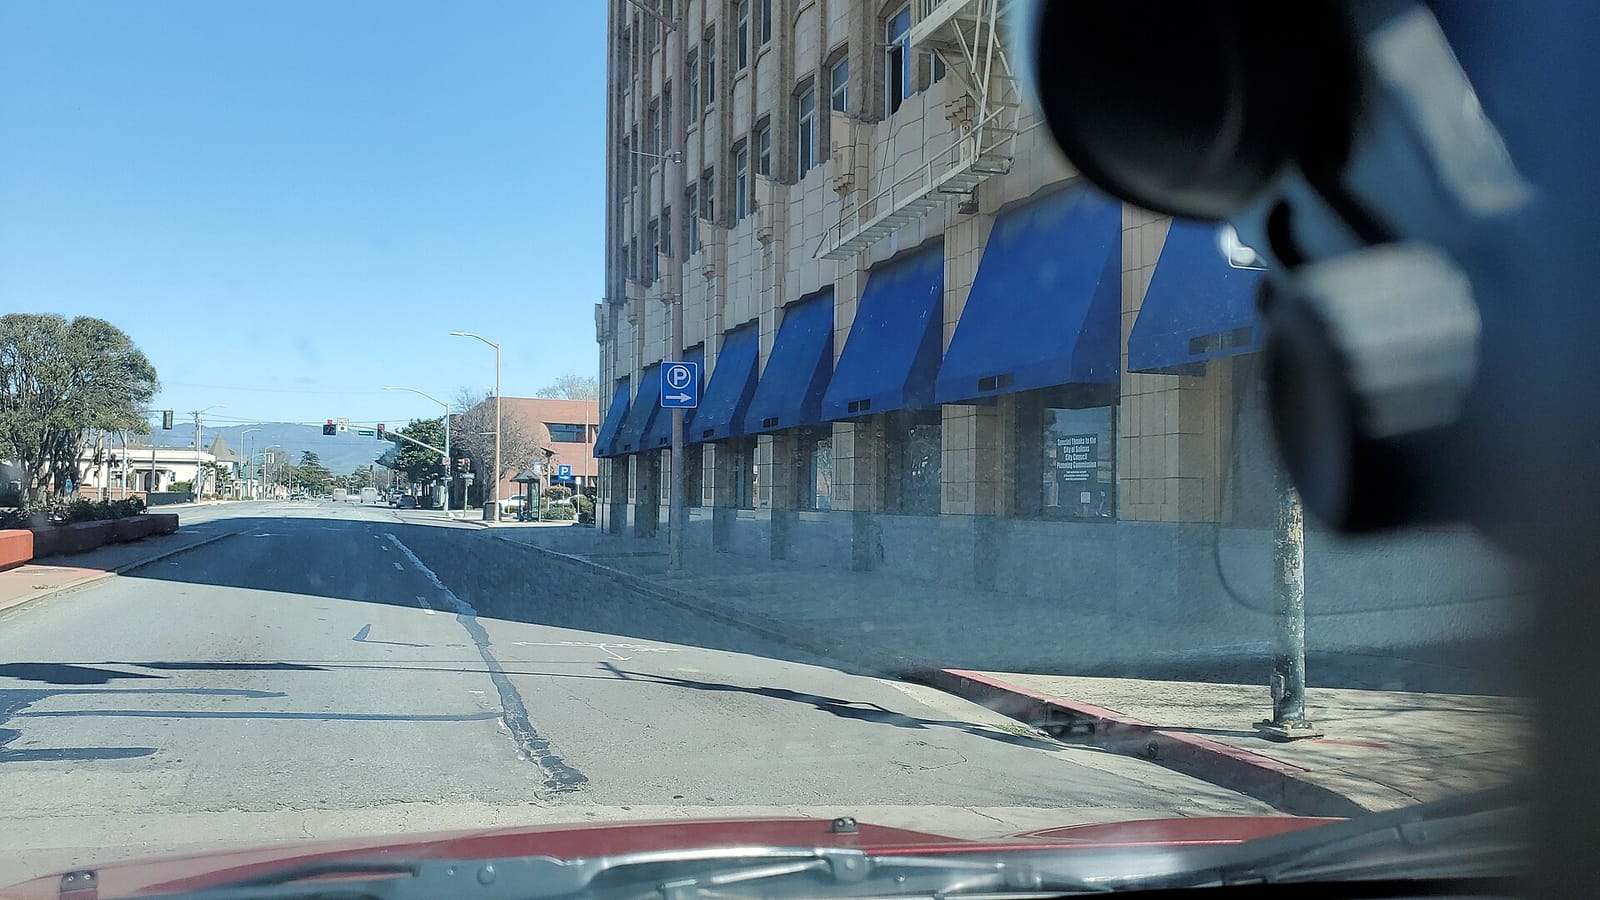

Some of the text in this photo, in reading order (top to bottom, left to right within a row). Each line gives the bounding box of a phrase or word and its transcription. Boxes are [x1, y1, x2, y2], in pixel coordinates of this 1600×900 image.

[673, 368, 687, 386] P
[1076, 445, 1090, 453] Salinas
[1073, 453, 1088, 461] Council
[1073, 461, 1097, 469] Commission
[561, 467, 569, 475] P
